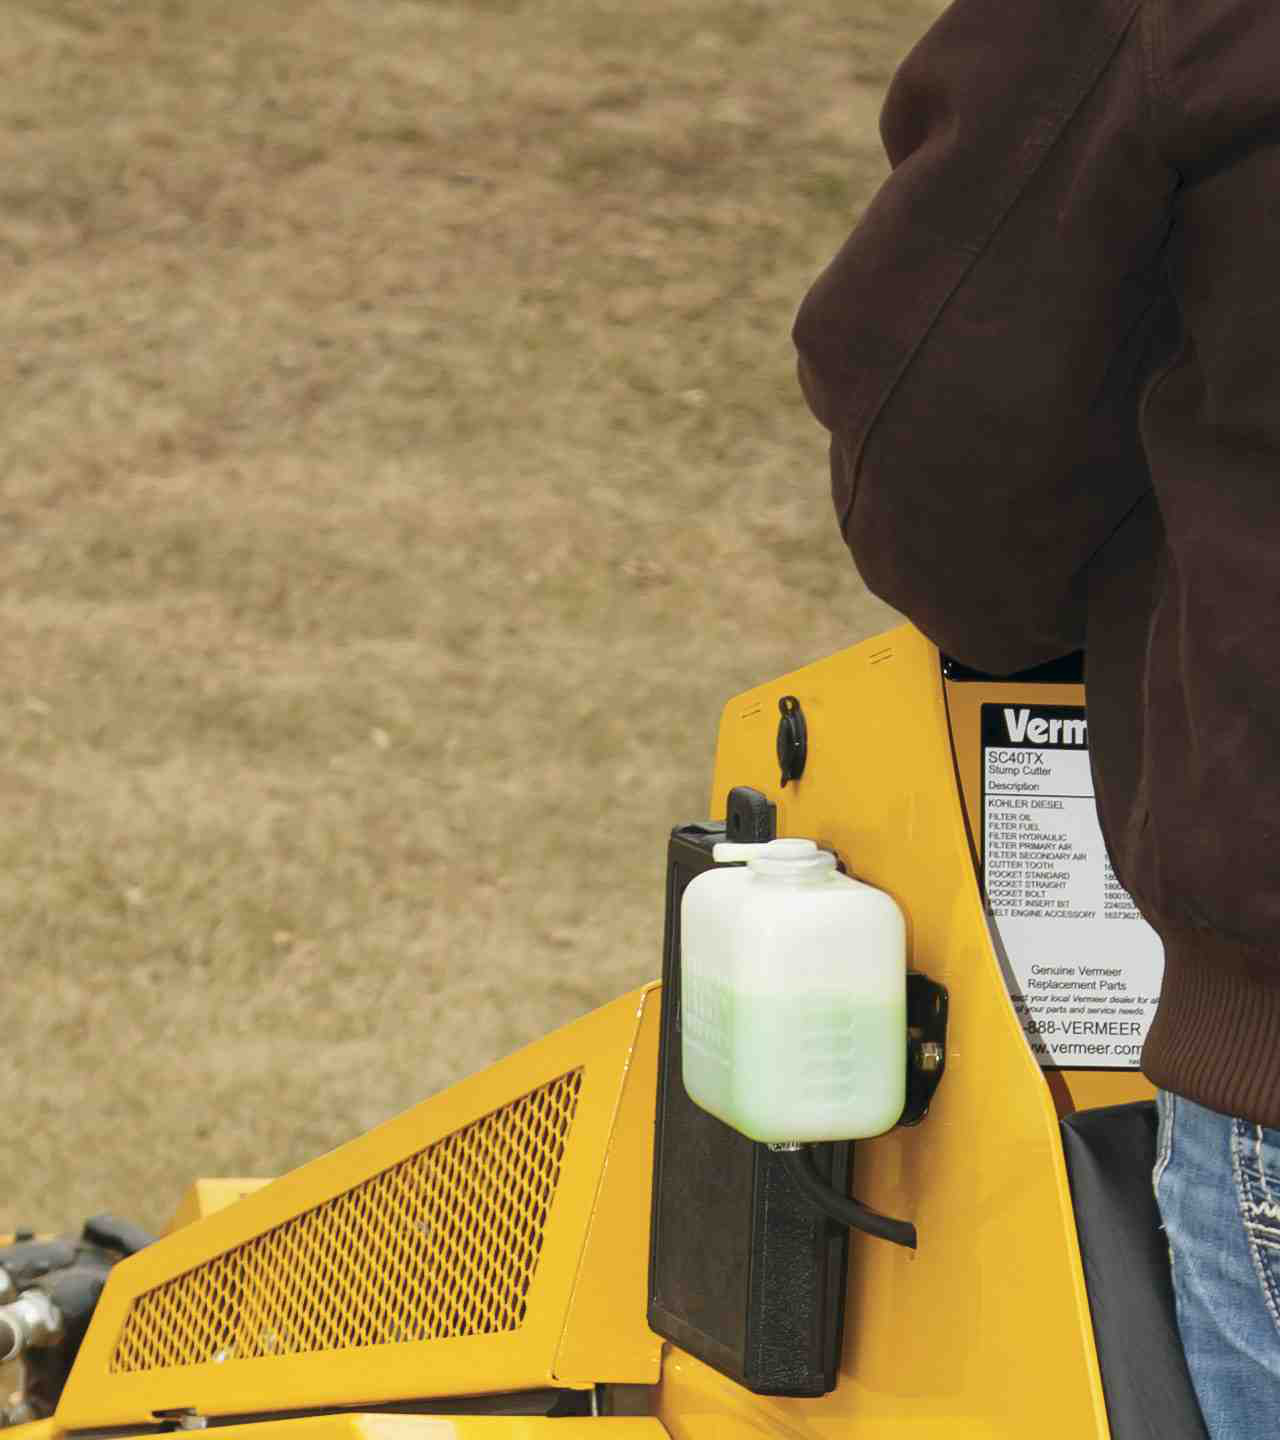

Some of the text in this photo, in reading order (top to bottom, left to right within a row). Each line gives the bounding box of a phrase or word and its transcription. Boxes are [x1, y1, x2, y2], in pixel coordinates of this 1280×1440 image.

[1003, 707, 1088, 745] Verm
[988, 750, 1044, 765] SC40TX
[988, 765, 1051, 776] Stump Cutter
[988, 780, 1040, 792] Description
[988, 799, 1064, 810] KOHLER DIESEL
[988, 813, 1017, 821] FILTER
[988, 822, 1041, 831] FILTER FUEL
[988, 832, 1069, 842] FILTER HYDRAULIC
[988, 841, 1073, 851] FILTER PRIMARY AIR
[988, 851, 1088, 861] FILTER SECONDARY AIR
[988, 861, 1054, 870] CUTTER TOOTH
[988, 870, 1070, 880] POCKET STANDARD
[988, 880, 1023, 888] POCKET
[1024, 880, 1067, 889] STRAIGHT
[988, 889, 1023, 897] POCKET
[1024, 890, 1046, 898] BOLT
[1025, 900, 1056, 908] INSERT
[1010, 909, 1043, 918] ENGINE
[1044, 910, 1096, 919] ACCESSORY
[1031, 964, 1122, 977] Genuine Vermeer
[1027, 978, 1127, 991] Replacement Parts
[1030, 995, 1049, 1004] your
[1050, 994, 1071, 1002] local
[1073, 995, 1108, 1003] Vermeer
[1109, 996, 1135, 1004] dealer
[1137, 996, 1149, 1005] for
[1045, 1006, 1067, 1015] parts
[1069, 1006, 1086, 1014] and
[1087, 1007, 1117, 1015] service
[1024, 1020, 1142, 1036] -888-VERMEER
